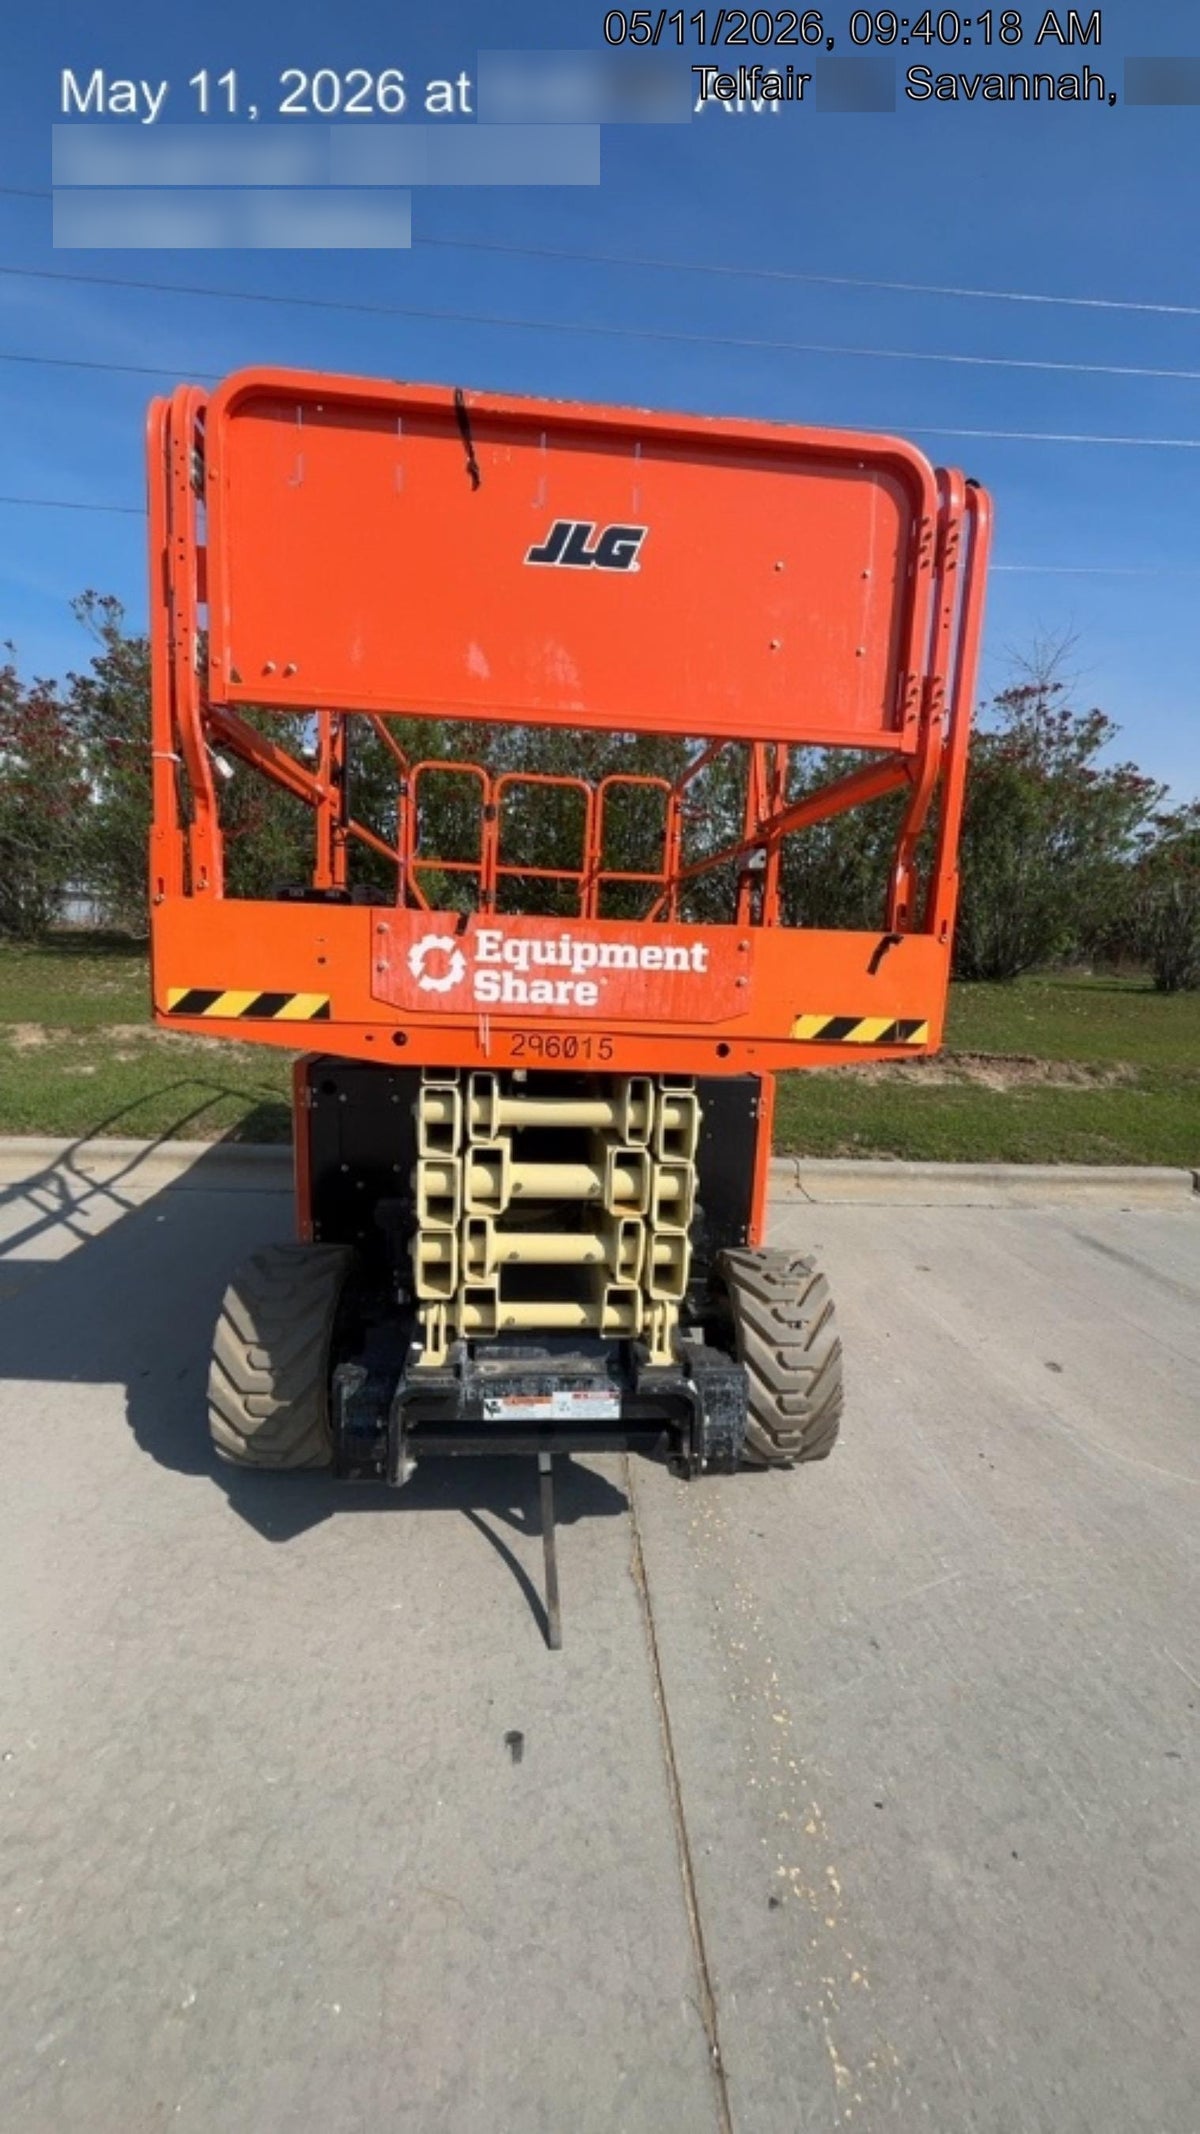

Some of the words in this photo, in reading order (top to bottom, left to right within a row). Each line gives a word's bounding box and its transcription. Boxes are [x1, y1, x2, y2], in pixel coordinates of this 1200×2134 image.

[523, 518, 648, 572] JLG
[474, 929, 709, 974] Equipment
[473, 969, 599, 1006] Share
[510, 1033, 613, 1060] 296015
